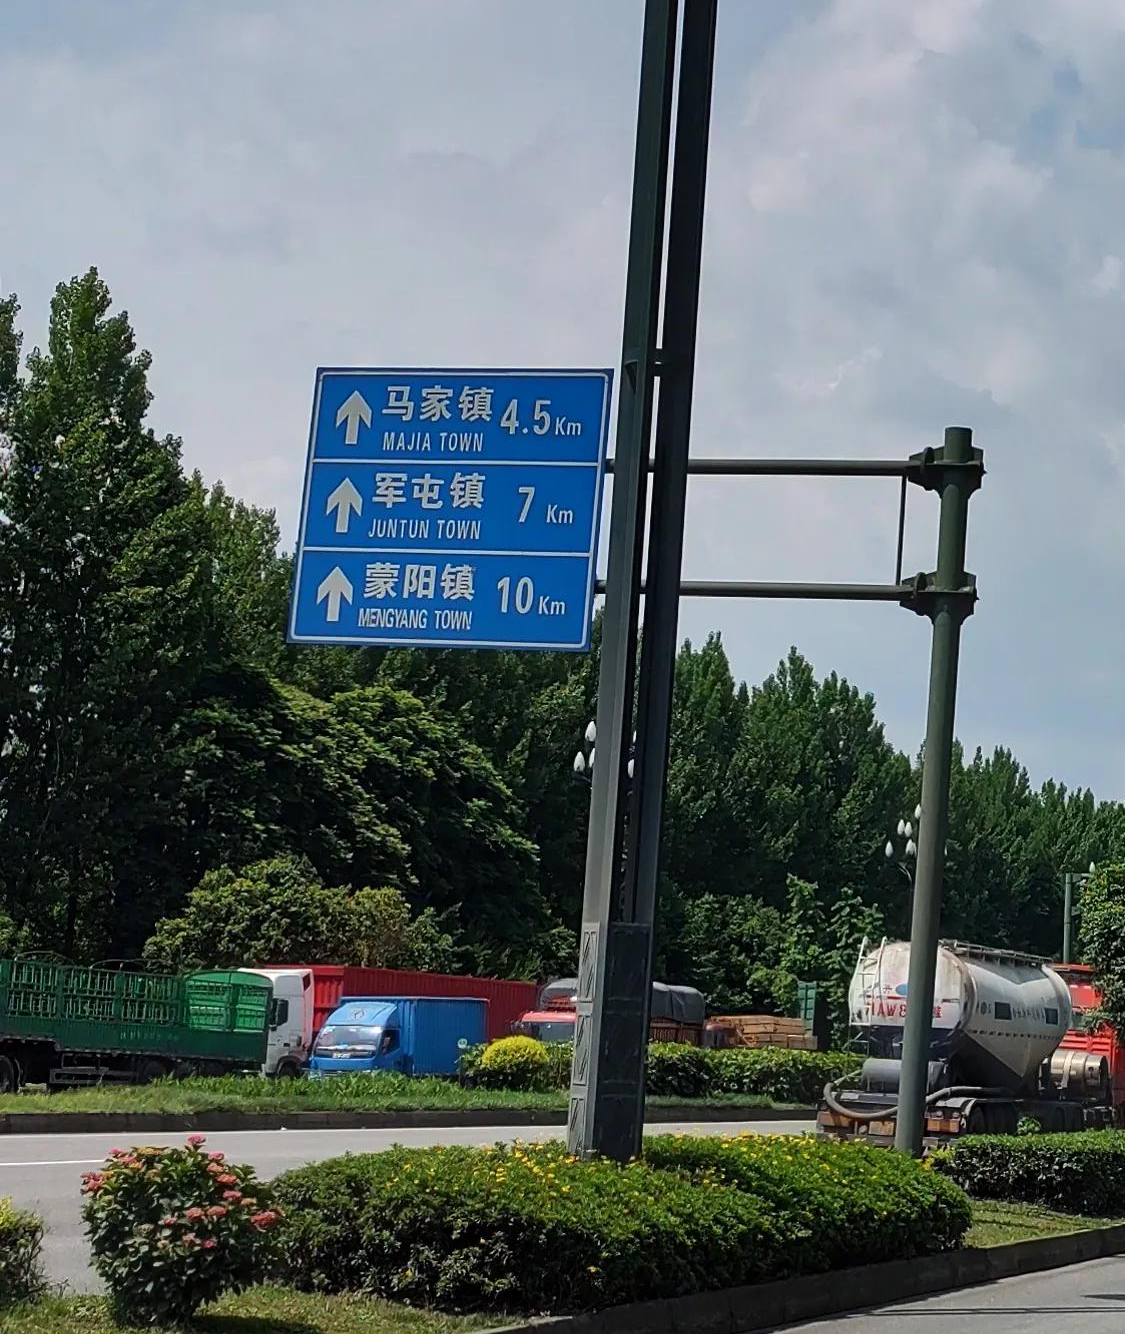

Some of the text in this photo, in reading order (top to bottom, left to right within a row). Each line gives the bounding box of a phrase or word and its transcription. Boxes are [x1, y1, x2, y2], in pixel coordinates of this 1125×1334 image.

[381, 385, 582, 436] 马家镇 4.5 Km
[382, 432, 484, 452] MAJIA TOWN
[371, 472, 574, 524] 军屯镇 7 Km
[367, 519, 481, 540] JUNTUN TOWN
[362, 562, 566, 615] 蒙阳镇 10 Km
[358, 607, 473, 630] MENGYANG TOWN
